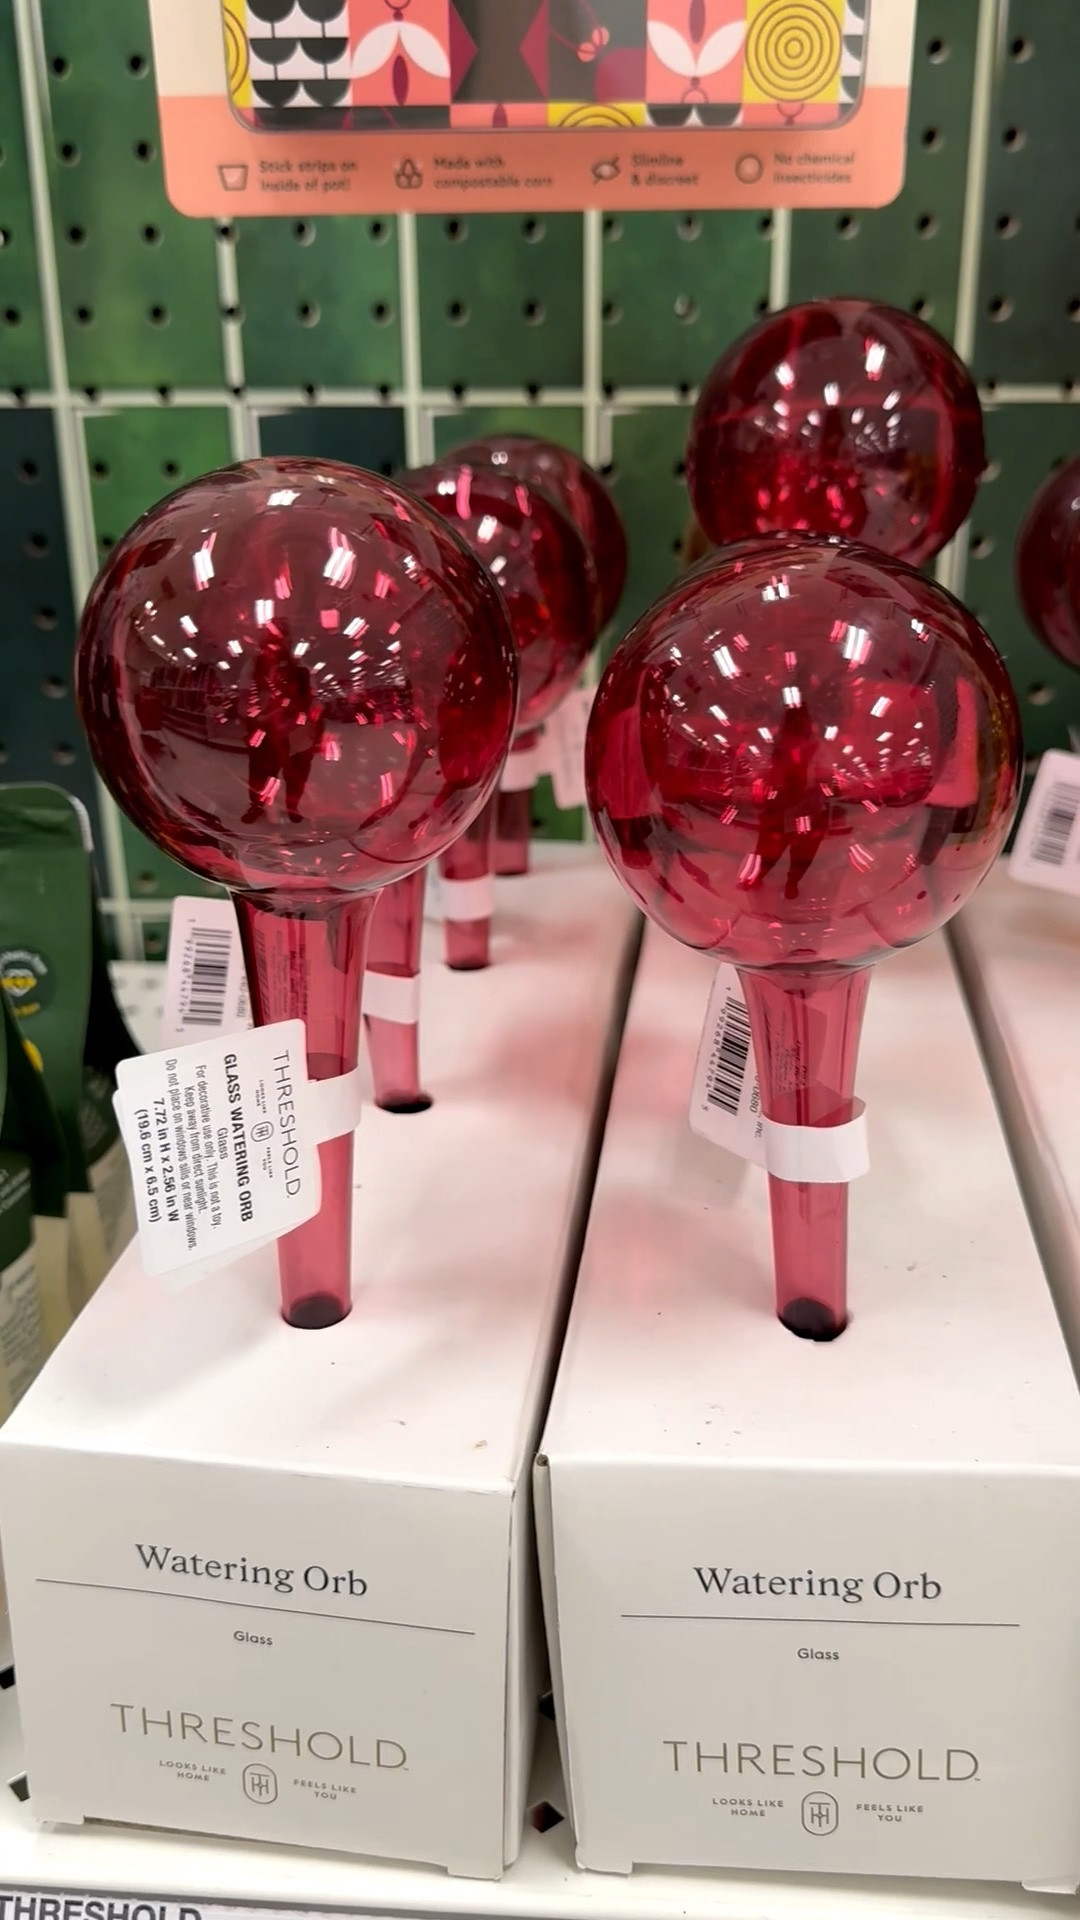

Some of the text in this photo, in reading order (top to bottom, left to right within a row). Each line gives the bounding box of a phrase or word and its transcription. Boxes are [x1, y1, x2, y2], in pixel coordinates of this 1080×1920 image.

[196, 1065, 206, 1078] For
[198, 1080, 212, 1123] decorative
[202, 1125, 212, 1140] use
[224, 1054, 253, 1222] GLASS WATERING ORB
[184, 1086, 208, 1214] Keep away from direct sunlight.
[204, 1141, 216, 1161] only.
[217, 1128, 228, 1160] Glass
[153, 1098, 180, 1222] 7.72 in H x 2.56 in W
[166, 1058, 197, 1250] Do not place on windows sills or near windows.
[134, 1108, 162, 1223] (19.6 cm x 6.5 cm)
[207, 1162, 218, 1180] This
[209, 1181, 219, 1190] is
[210, 1191, 220, 1205] not
[210, 1212, 222, 1229] toy.
[135, 1543, 368, 1597] Watering Orb
[693, 1566, 942, 1604] Watering Orb
[233, 1629, 273, 1646] Glass
[797, 1647, 840, 1661] Glass
[159, 1760, 226, 1775] LOOKS LIKE
[177, 1772, 210, 1782] HOME
[294, 1778, 356, 1794] FEELS LIKE
[314, 1791, 337, 1800] YOU
[712, 1798, 784, 1807] LOOKS LIKE
[731, 1808, 766, 1816] HOME
[856, 1804, 924, 1812] FEELS LIKE
[877, 1814, 902, 1822] YOU
